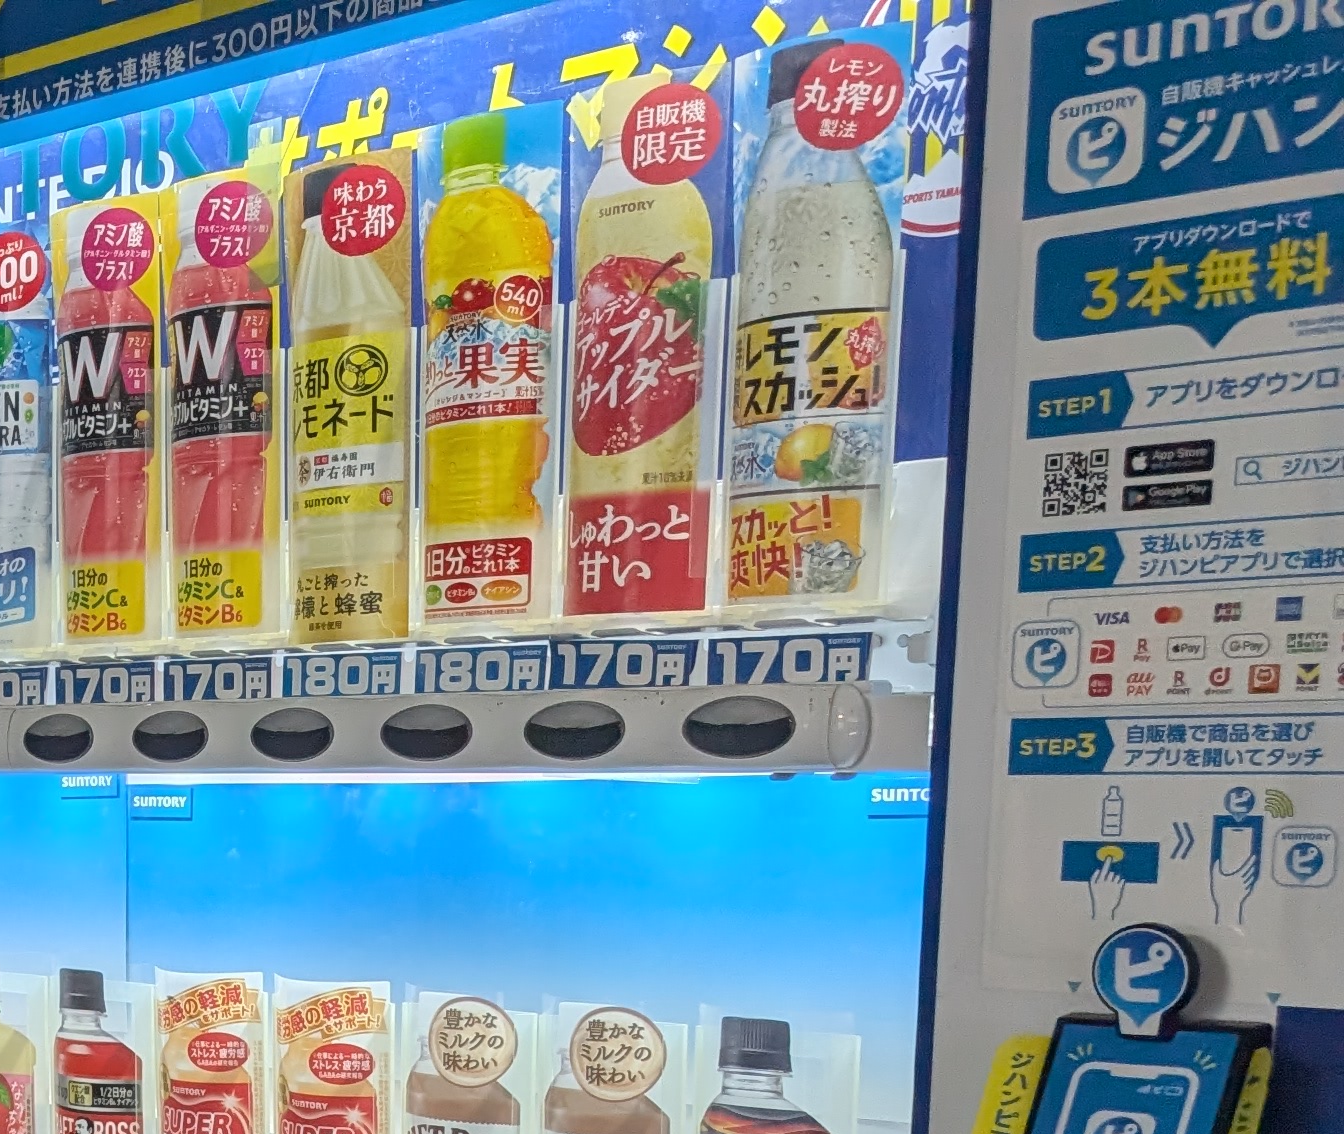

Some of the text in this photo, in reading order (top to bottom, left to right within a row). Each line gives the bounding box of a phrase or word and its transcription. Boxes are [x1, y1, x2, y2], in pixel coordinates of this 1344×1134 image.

[828, 57, 885, 78] レモン
[796, 77, 898, 118] 丸搾り
[1059, 94, 1138, 121] SUNTORY
[635, 98, 707, 130] 自販機
[817, 117, 858, 141] 製法
[632, 126, 707, 168] 限定
[332, 178, 388, 208] 味わう
[207, 192, 262, 223] アミノ酸
[598, 199, 655, 219] SUNTORY
[93, 220, 143, 248] アミノ酸
[331, 203, 396, 243] 京都
[1133, 210, 1313, 256] アプリダウンロードで
[209, 235, 251, 261] プラス!
[95, 259, 134, 282] プラス!
[1081, 231, 1332, 321] 3本無料
[500, 281, 539, 305] 540
[175, 309, 238, 386] W
[744, 321, 844, 371] レモン
[63, 331, 123, 402] W
[577, 346, 703, 422] サイダー
[313, 461, 375, 481] 伊右衛門
[303, 493, 351, 509] SUNTORY
[569, 502, 691, 550] しゅわっと
[1139, 528, 1266, 556] 支払い方法を
[71, 568, 108, 589] 1日分の
[183, 558, 223, 580] 1日分の
[578, 553, 653, 595] 甘い
[1094, 611, 1131, 625] VISA
[419, 649, 540, 693] 180円
[559, 642, 685, 688] 170円
[716, 637, 860, 685] 170円
[60, 664, 151, 704] 170円
[170, 661, 267, 701] 170円
[287, 655, 396, 697] 180円
[1125, 720, 1316, 744] 自販機で商品を選び
[1124, 746, 1325, 769] アプリを開いてタッチ
[62, 775, 113, 789] SUNTORY
[133, 794, 188, 809] SUNTORY
[1112, 940, 1174, 1003] ピ
[443, 1008, 497, 1029] 豊かな
[586, 1020, 644, 1042] 豊かな
[438, 1031, 504, 1051] ミルクの
[580, 1044, 652, 1064] ミルクの
[442, 1051, 498, 1072] 味わい
[585, 1064, 646, 1087] 味わい
